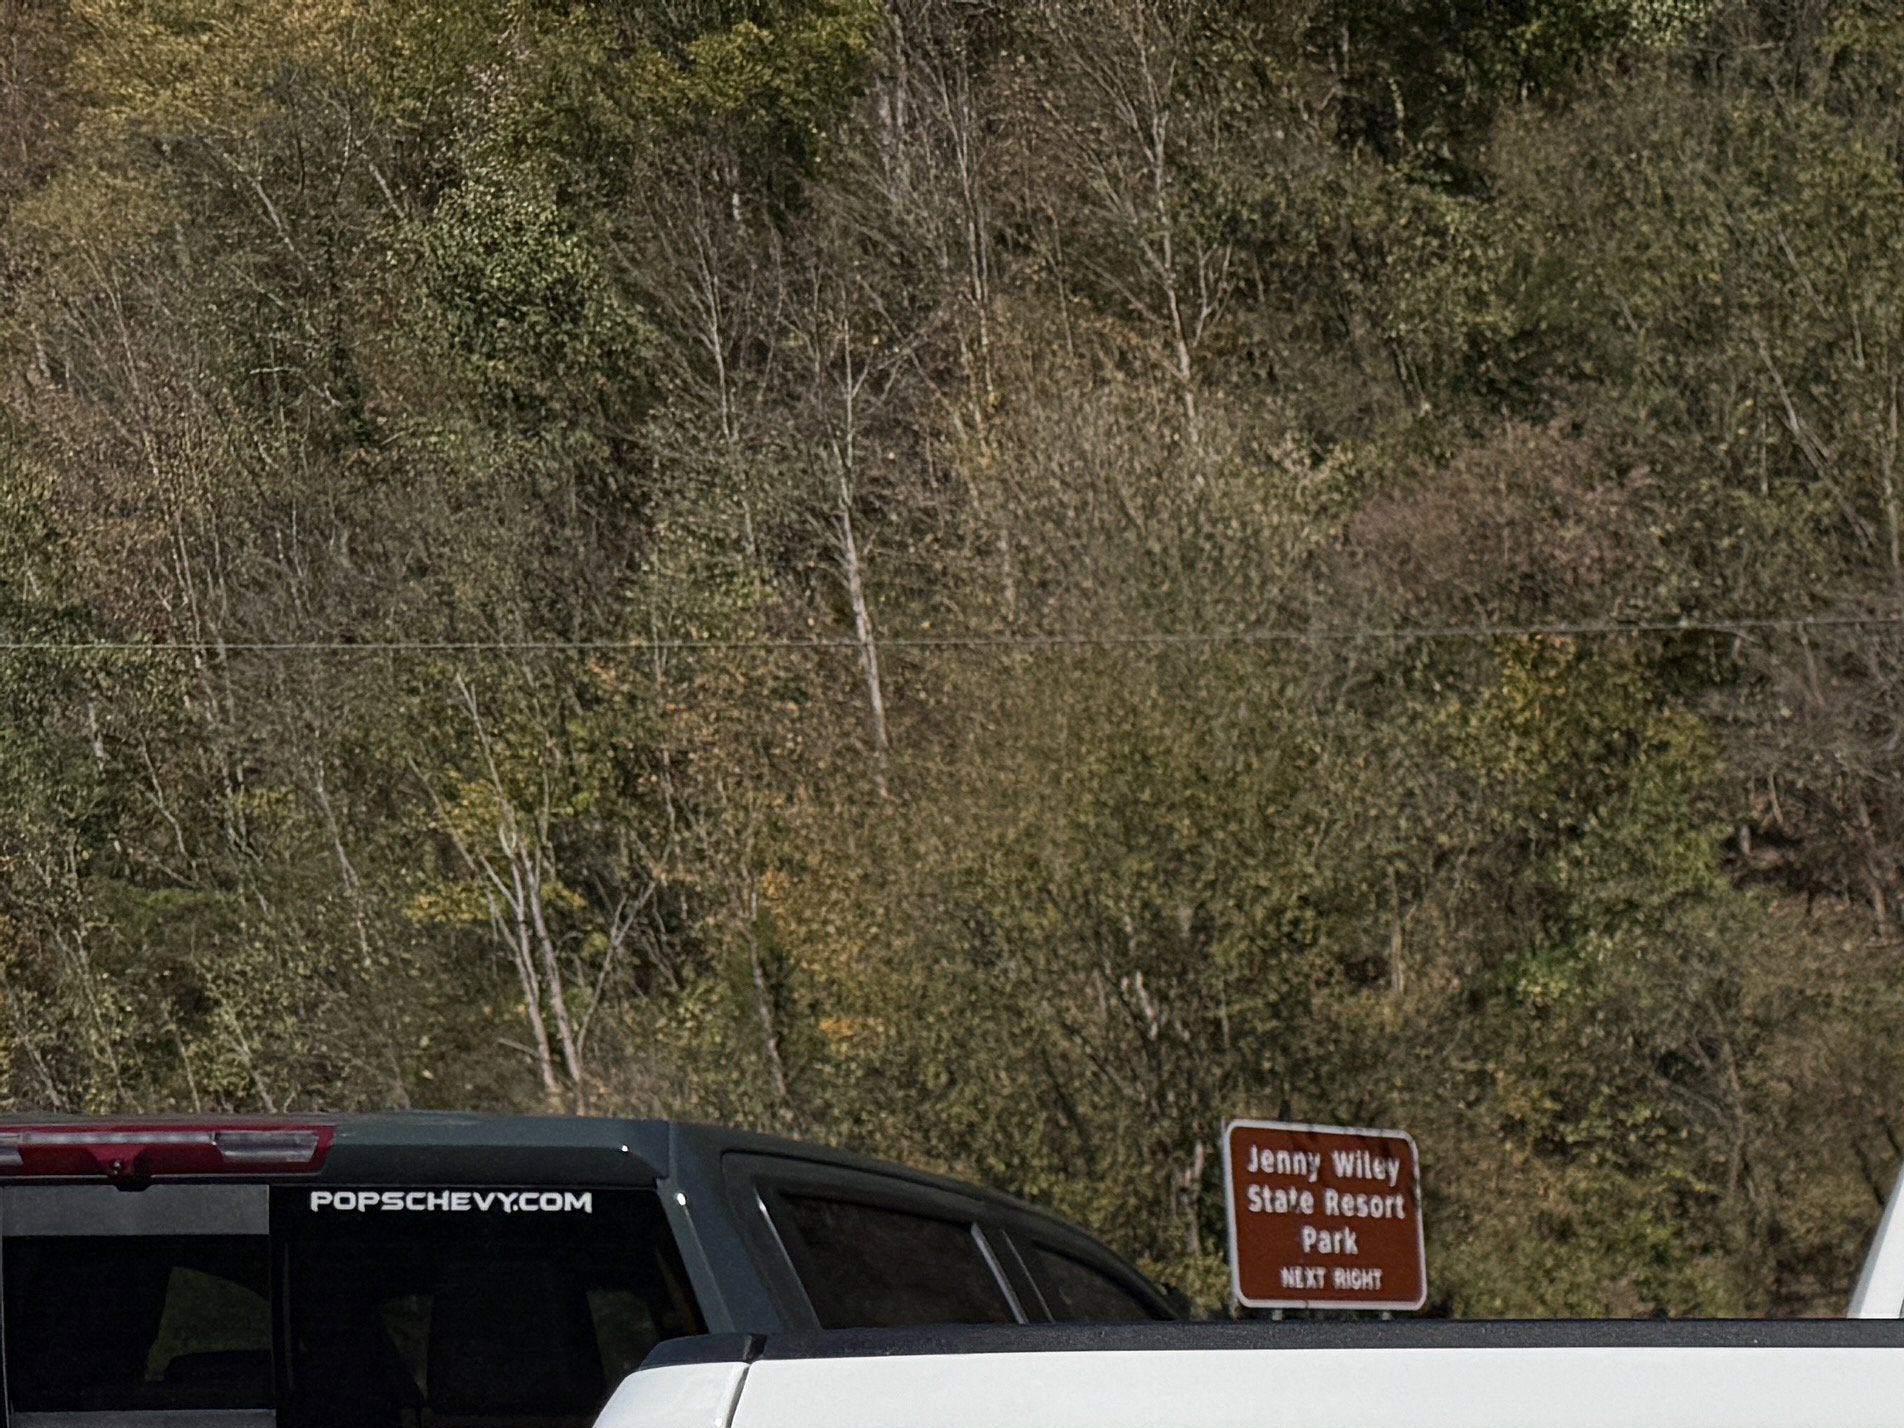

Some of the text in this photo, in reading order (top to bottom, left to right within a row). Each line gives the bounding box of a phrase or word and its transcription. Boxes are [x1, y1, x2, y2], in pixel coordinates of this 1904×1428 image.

[1248, 1144, 1400, 1187] Jenny Wiley
[310, 1190, 593, 1213] POPSCHEVY.COM
[1247, 1184, 1406, 1219] State Resort
[1302, 1225, 1359, 1254] Park
[1280, 1266, 1383, 1290] NEXT RIGHT
